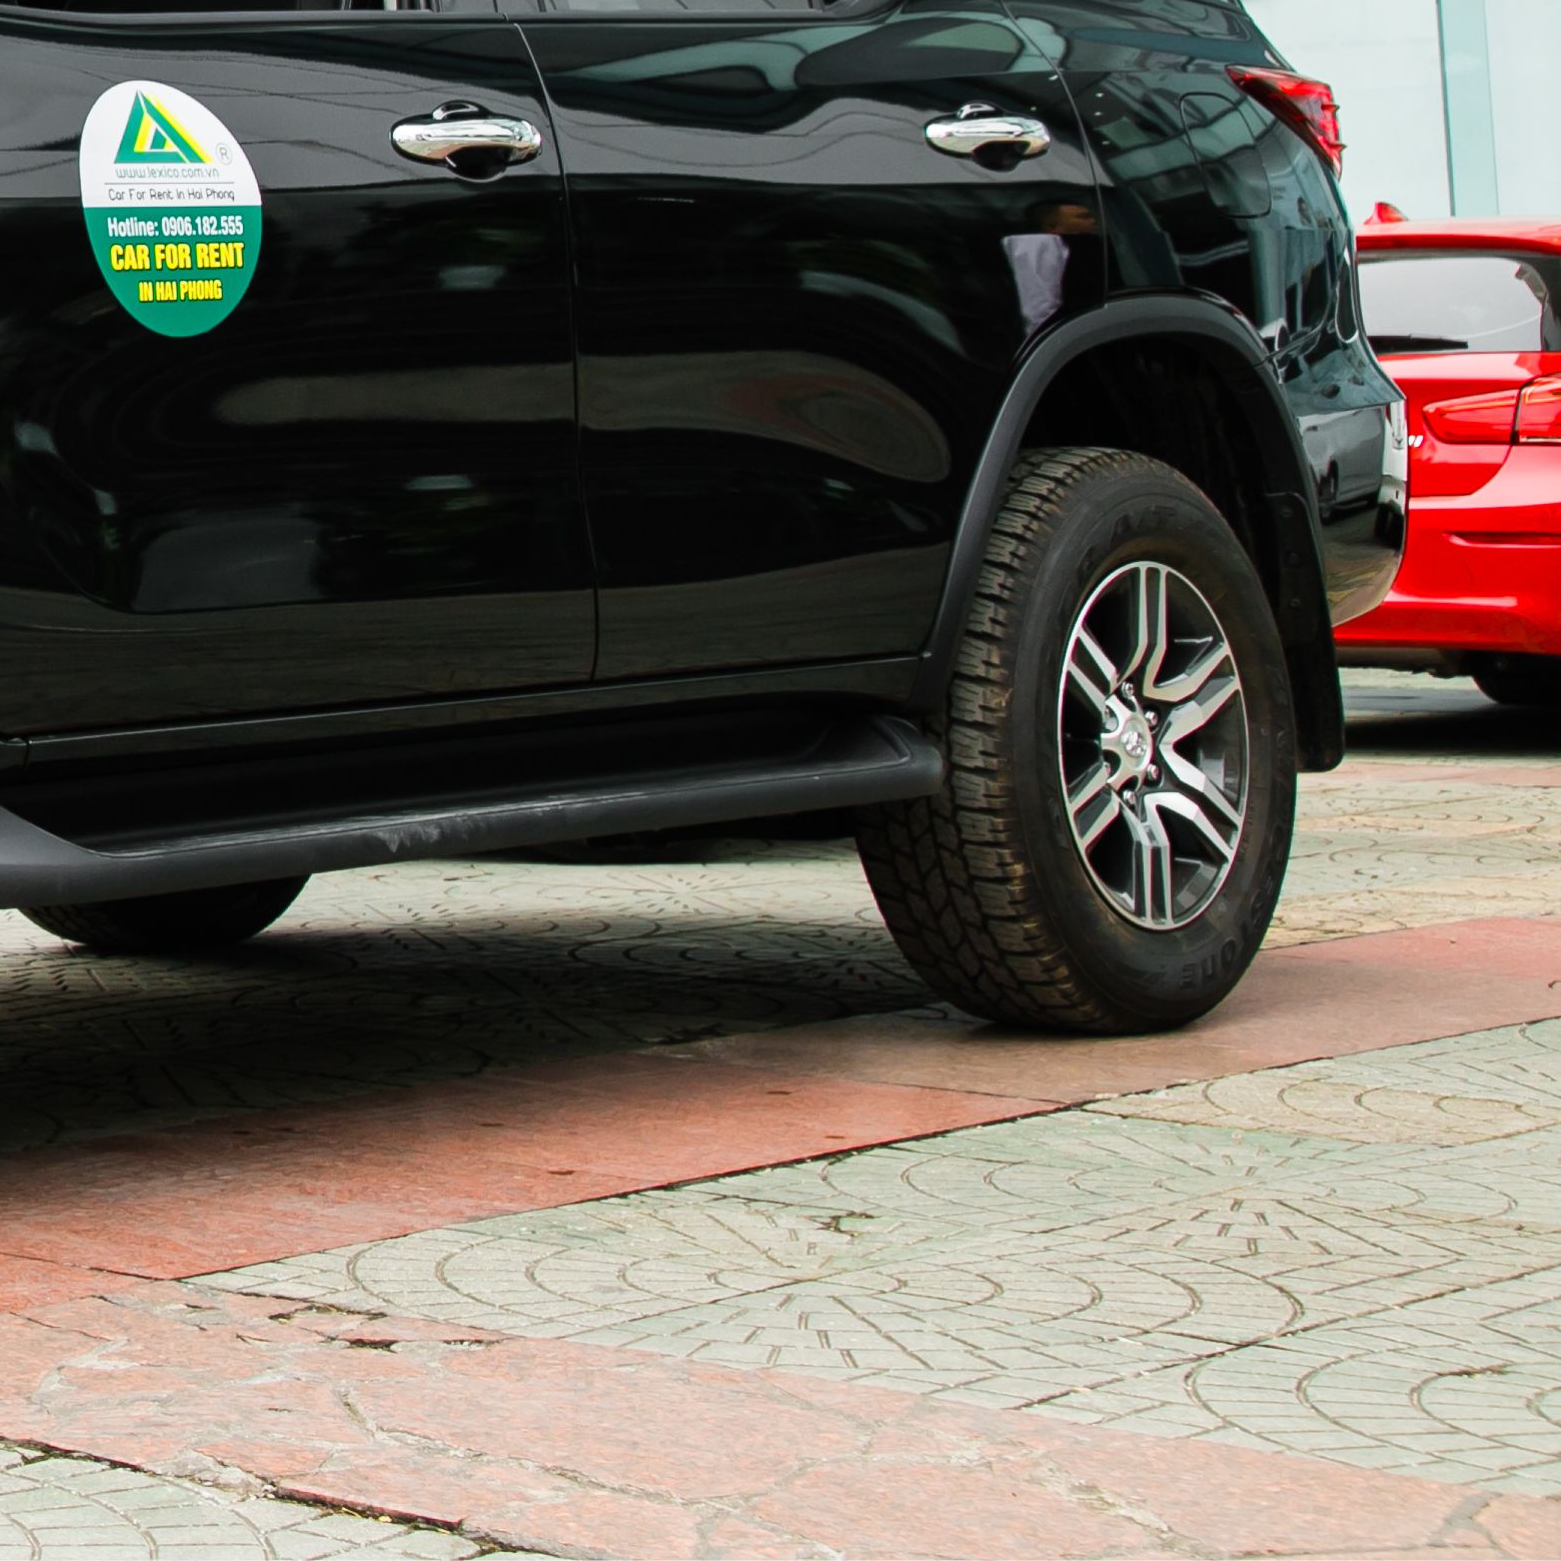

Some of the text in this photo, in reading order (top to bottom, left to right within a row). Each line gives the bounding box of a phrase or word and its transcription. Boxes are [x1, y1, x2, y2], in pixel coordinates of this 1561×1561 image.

[115, 166, 219, 179] www.lexico.com.vn
[108, 188, 125, 201] Car
[129, 188, 145, 200] For
[149, 188, 174, 200] Rent
[187, 187, 203, 199] Hai
[206, 187, 235, 202] Phong
[107, 215, 244, 237] Hotline: 0906.182.555
[110, 242, 245, 271] CAR FOR RENT
[139, 279, 222, 302] IN HAI PHONG
